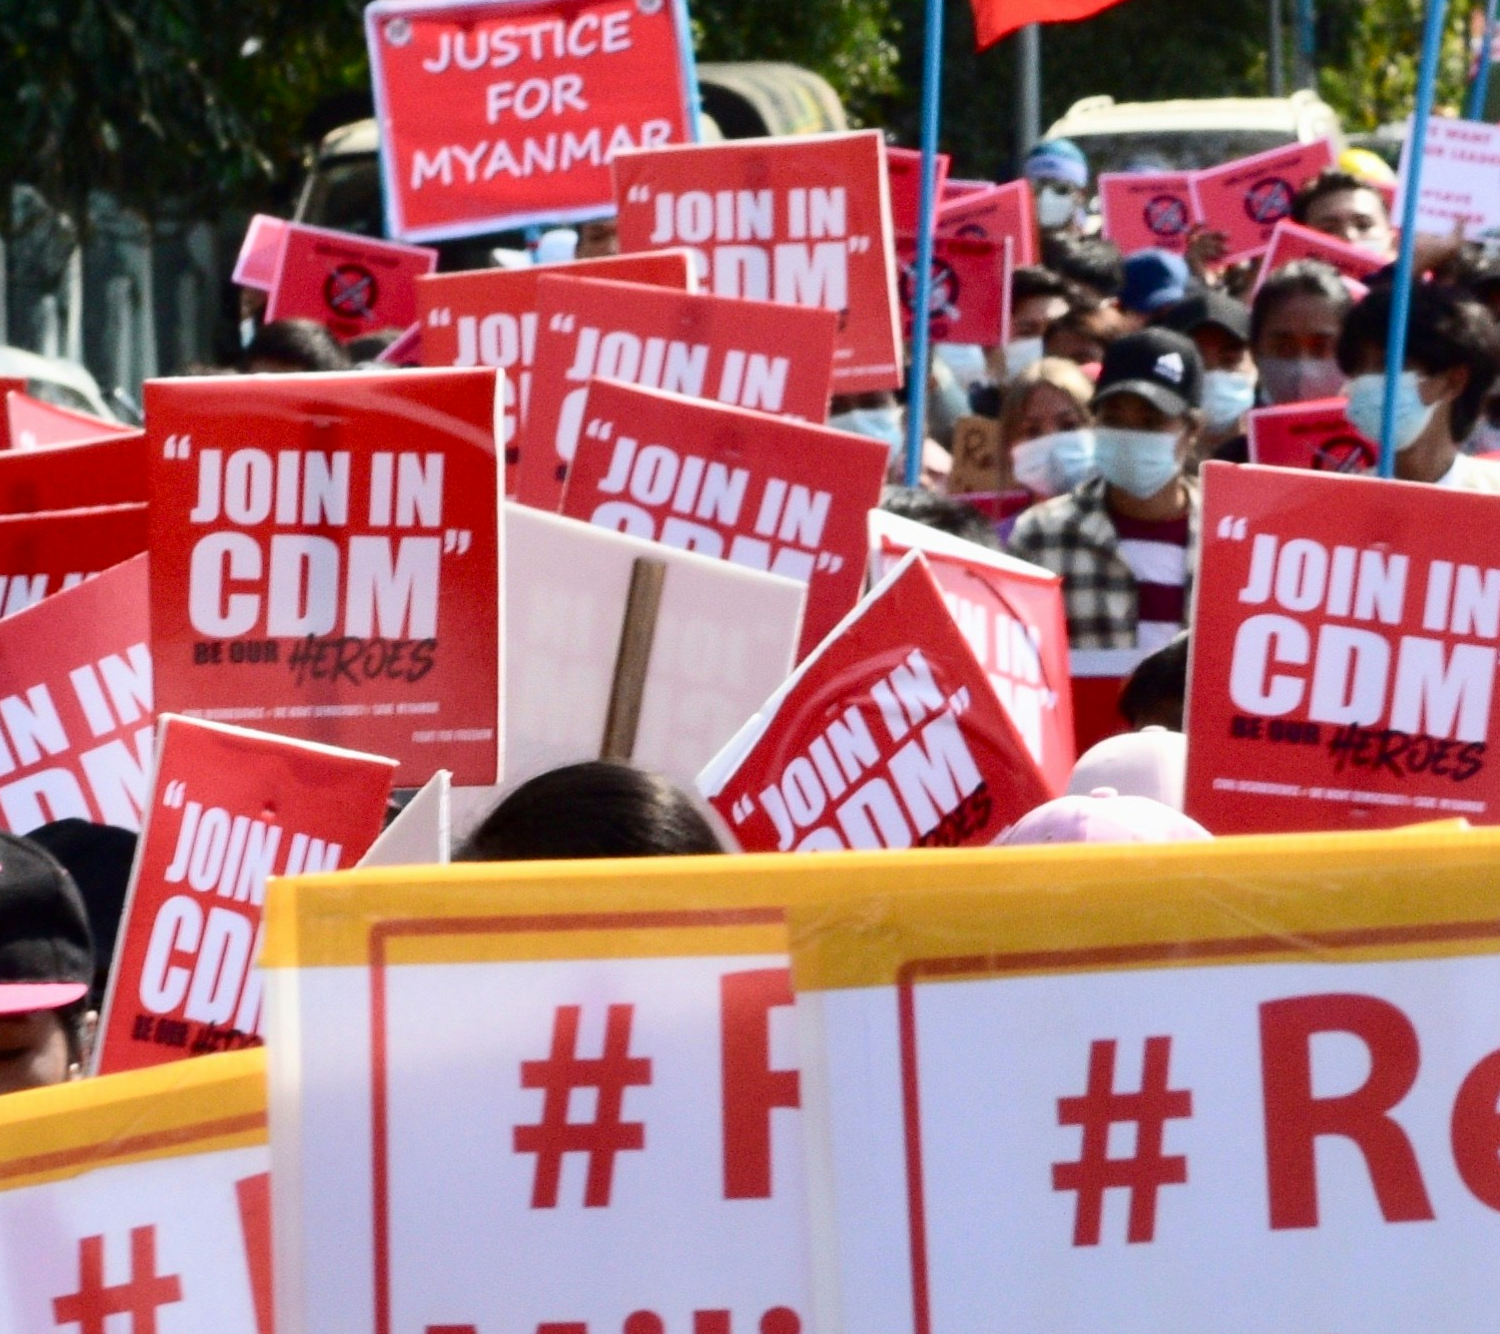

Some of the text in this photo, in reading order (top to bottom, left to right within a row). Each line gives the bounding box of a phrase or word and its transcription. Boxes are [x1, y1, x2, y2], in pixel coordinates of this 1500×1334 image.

[422, 11, 633, 73] JUSTICE
[485, 74, 588, 125] FOR
[410, 119, 673, 190] MYANMAR
[788, 187, 846, 240] IN
[717, 349, 790, 412] IN
[163, 433, 445, 528] “JOIN IN
[586, 418, 833, 549] “JOIN IN
[188, 528, 472, 641] CDM”
[1216, 515, 1410, 626] “JOIN
[69, 642, 154, 737] IN
[286, 632, 438, 687] HEROES
[995, 613, 1042, 684] IN
[731, 647, 945, 853] “JOIN IN
[794, 685, 987, 854] DM”
[1327, 720, 1487, 783] HEROES
[512, 1002, 653, 1210] #
[1048, 1034, 1193, 1249] #
